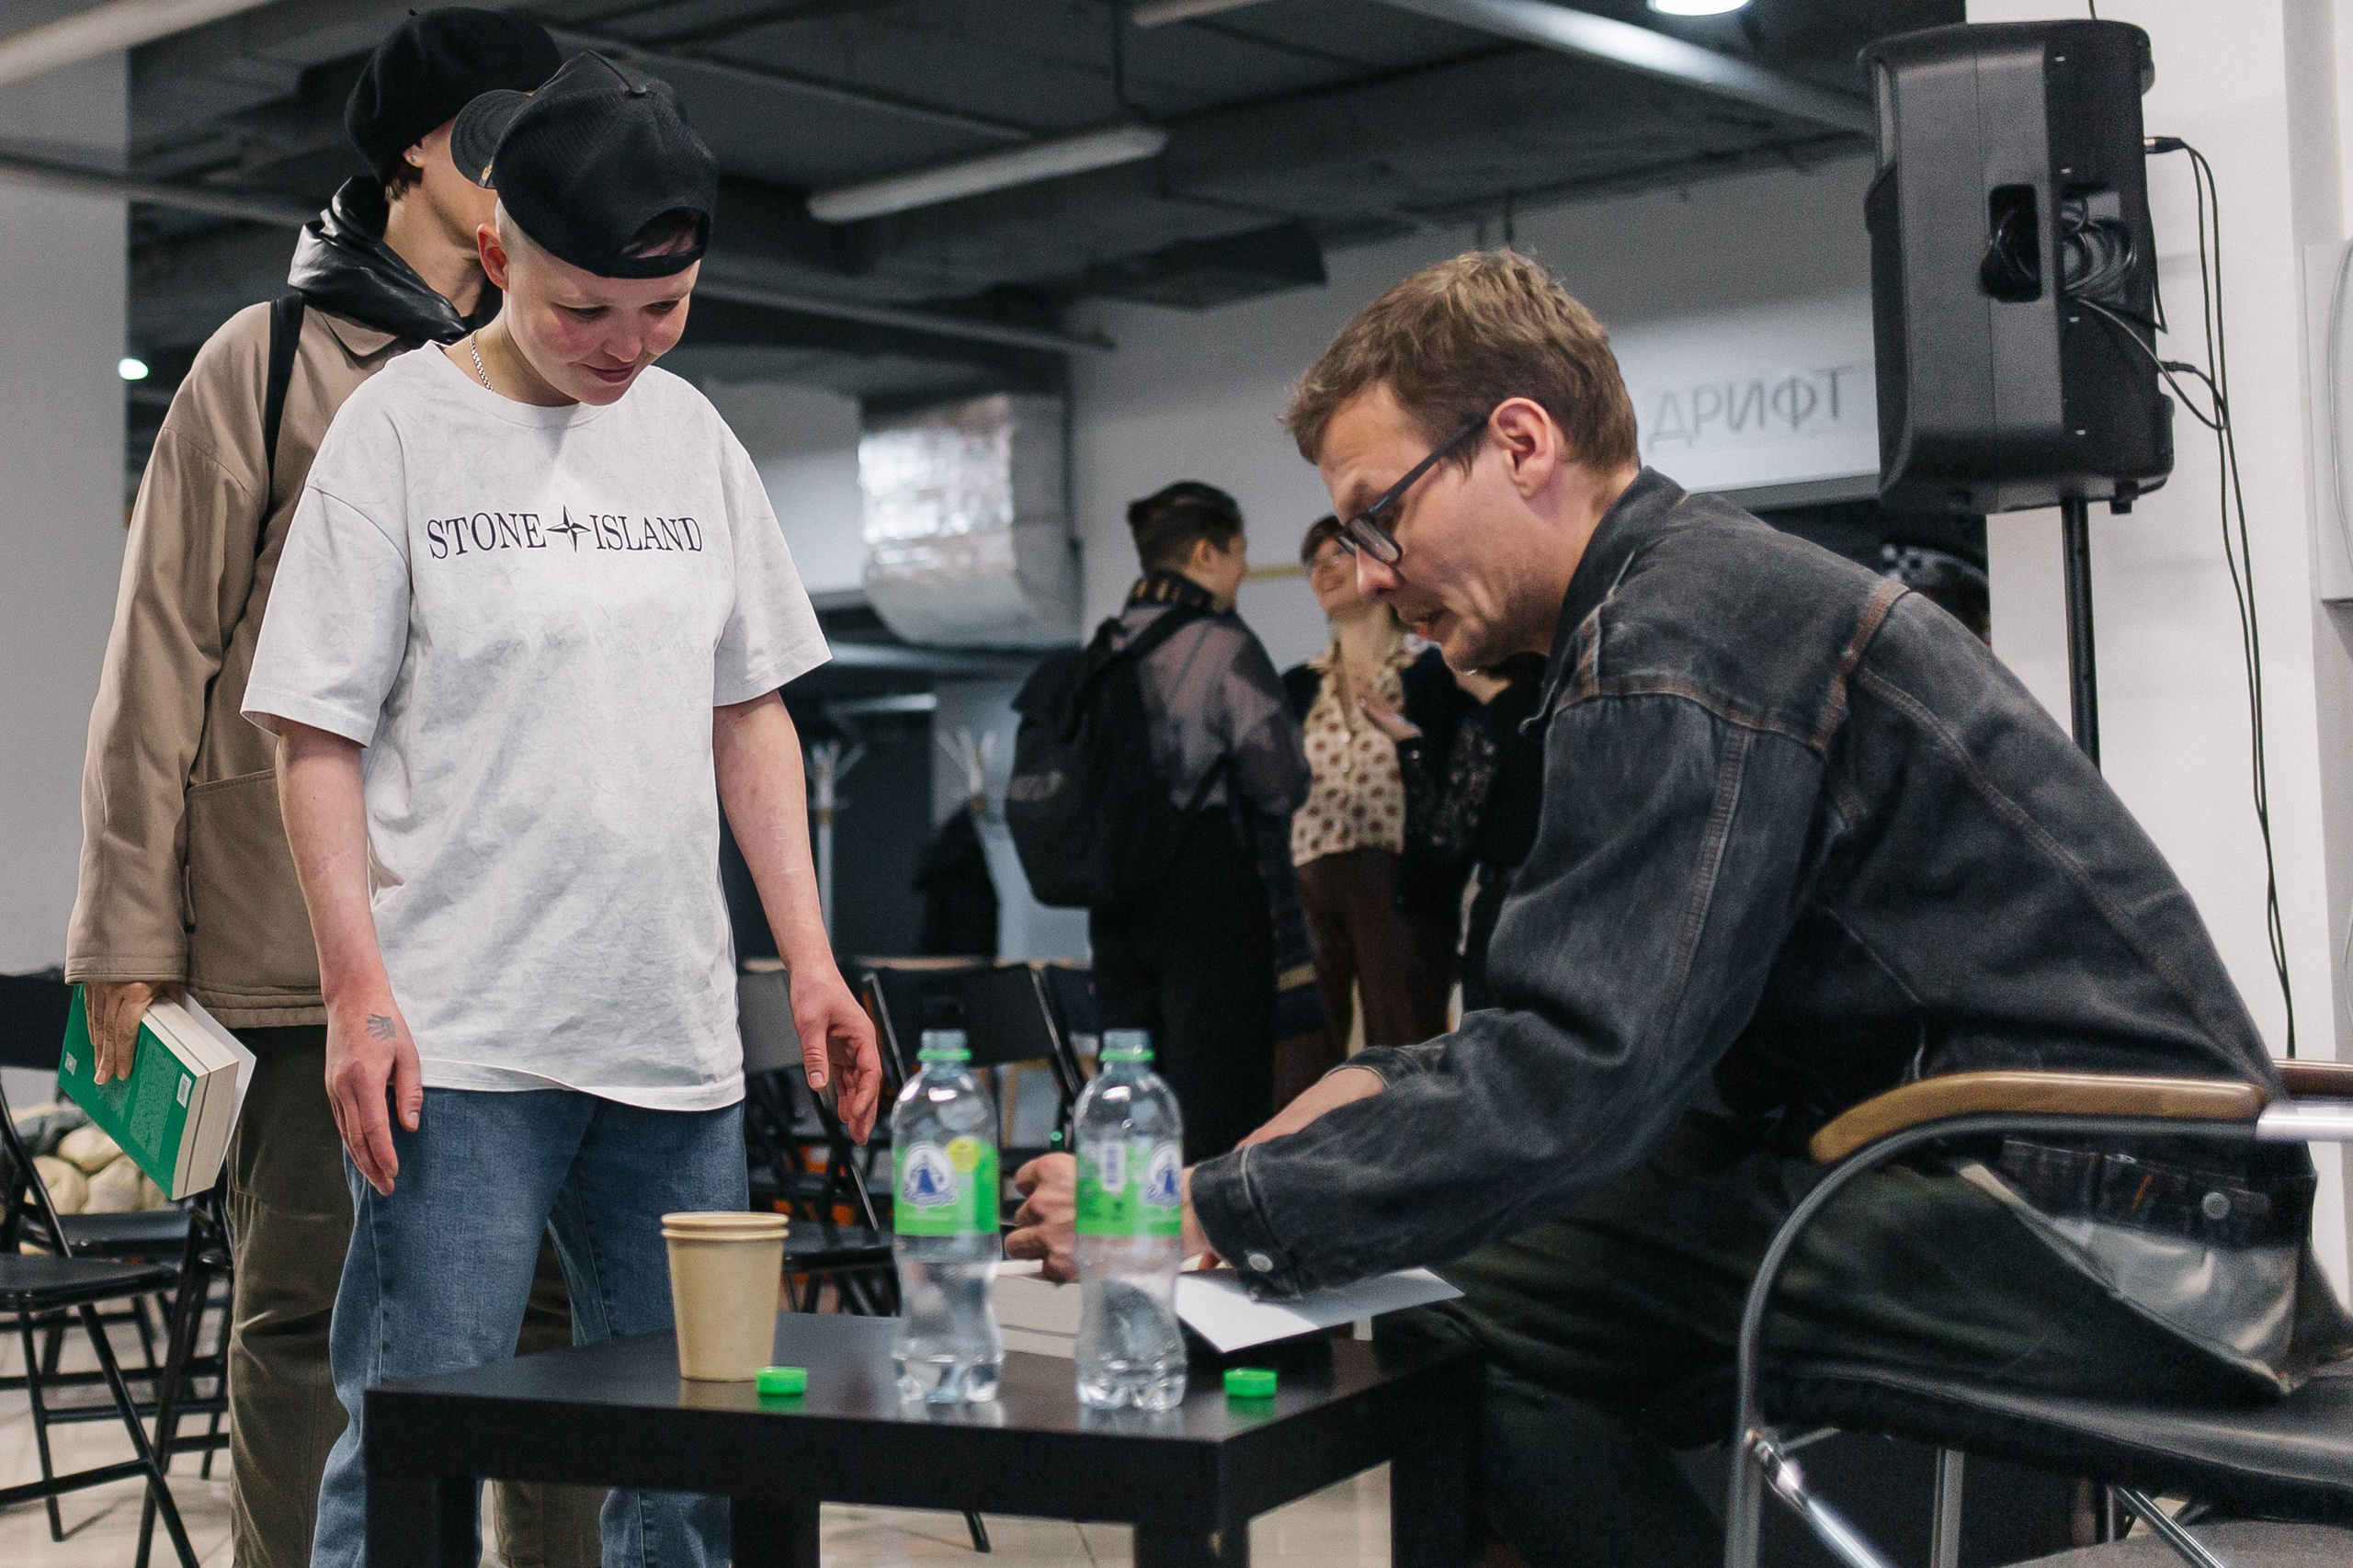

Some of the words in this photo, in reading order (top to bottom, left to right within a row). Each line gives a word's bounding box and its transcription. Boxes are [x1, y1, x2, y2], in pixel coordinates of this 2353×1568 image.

[1646, 367, 1854, 451] ДРИФТ
[427, 513, 547, 559] STONE
[589, 515, 702, 551] ISLAND
